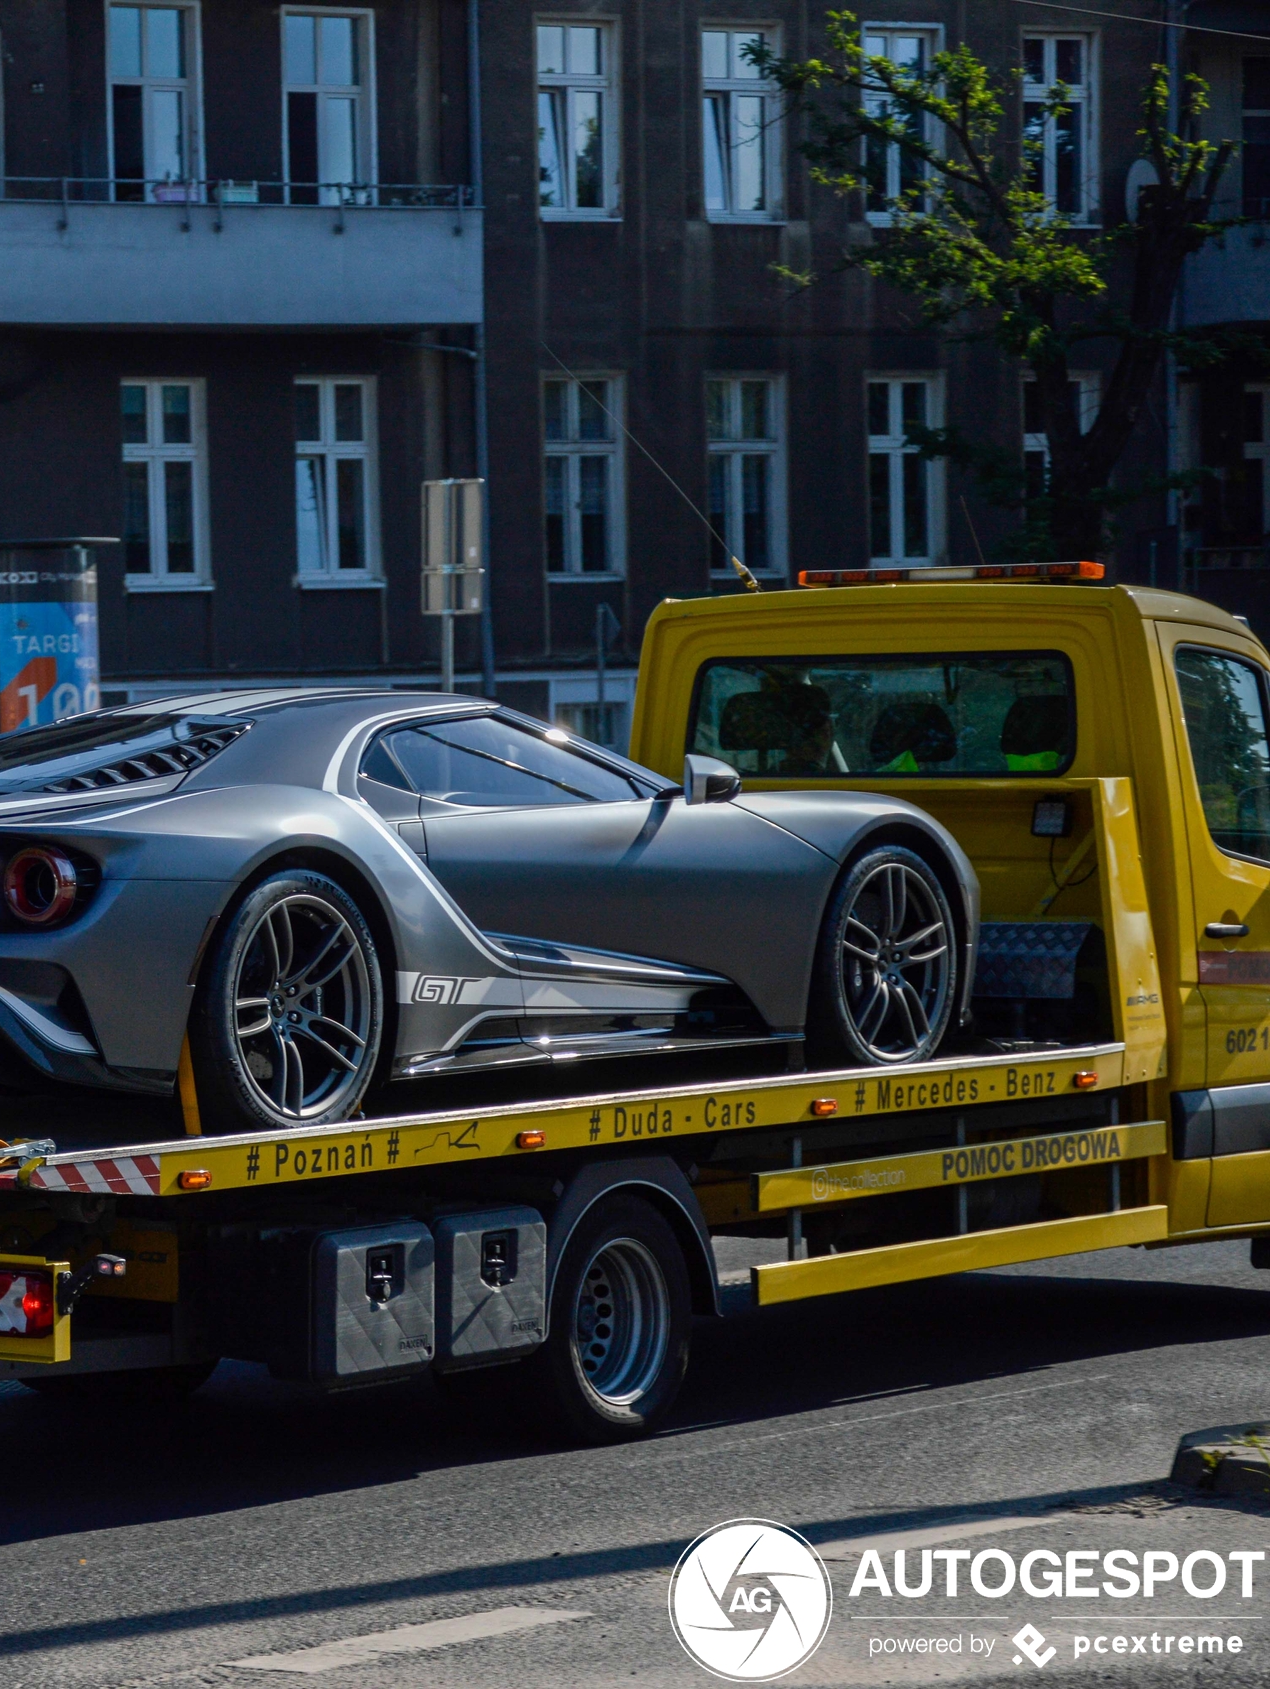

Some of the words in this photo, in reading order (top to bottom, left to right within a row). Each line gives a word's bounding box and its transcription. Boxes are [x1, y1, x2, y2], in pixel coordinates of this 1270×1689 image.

[12, 634, 80, 654] TARGI
[412, 974, 484, 1004] GT
[1225, 1027, 1257, 1054] 602
[877, 1074, 978, 1109] Mercedes
[1006, 1069, 1055, 1097] Benz
[614, 1103, 672, 1138] Duda
[704, 1097, 756, 1128] Cars
[275, 1133, 373, 1177] Poznań
[942, 1148, 1015, 1181] POMOC
[1021, 1131, 1121, 1169] DROGOWA
